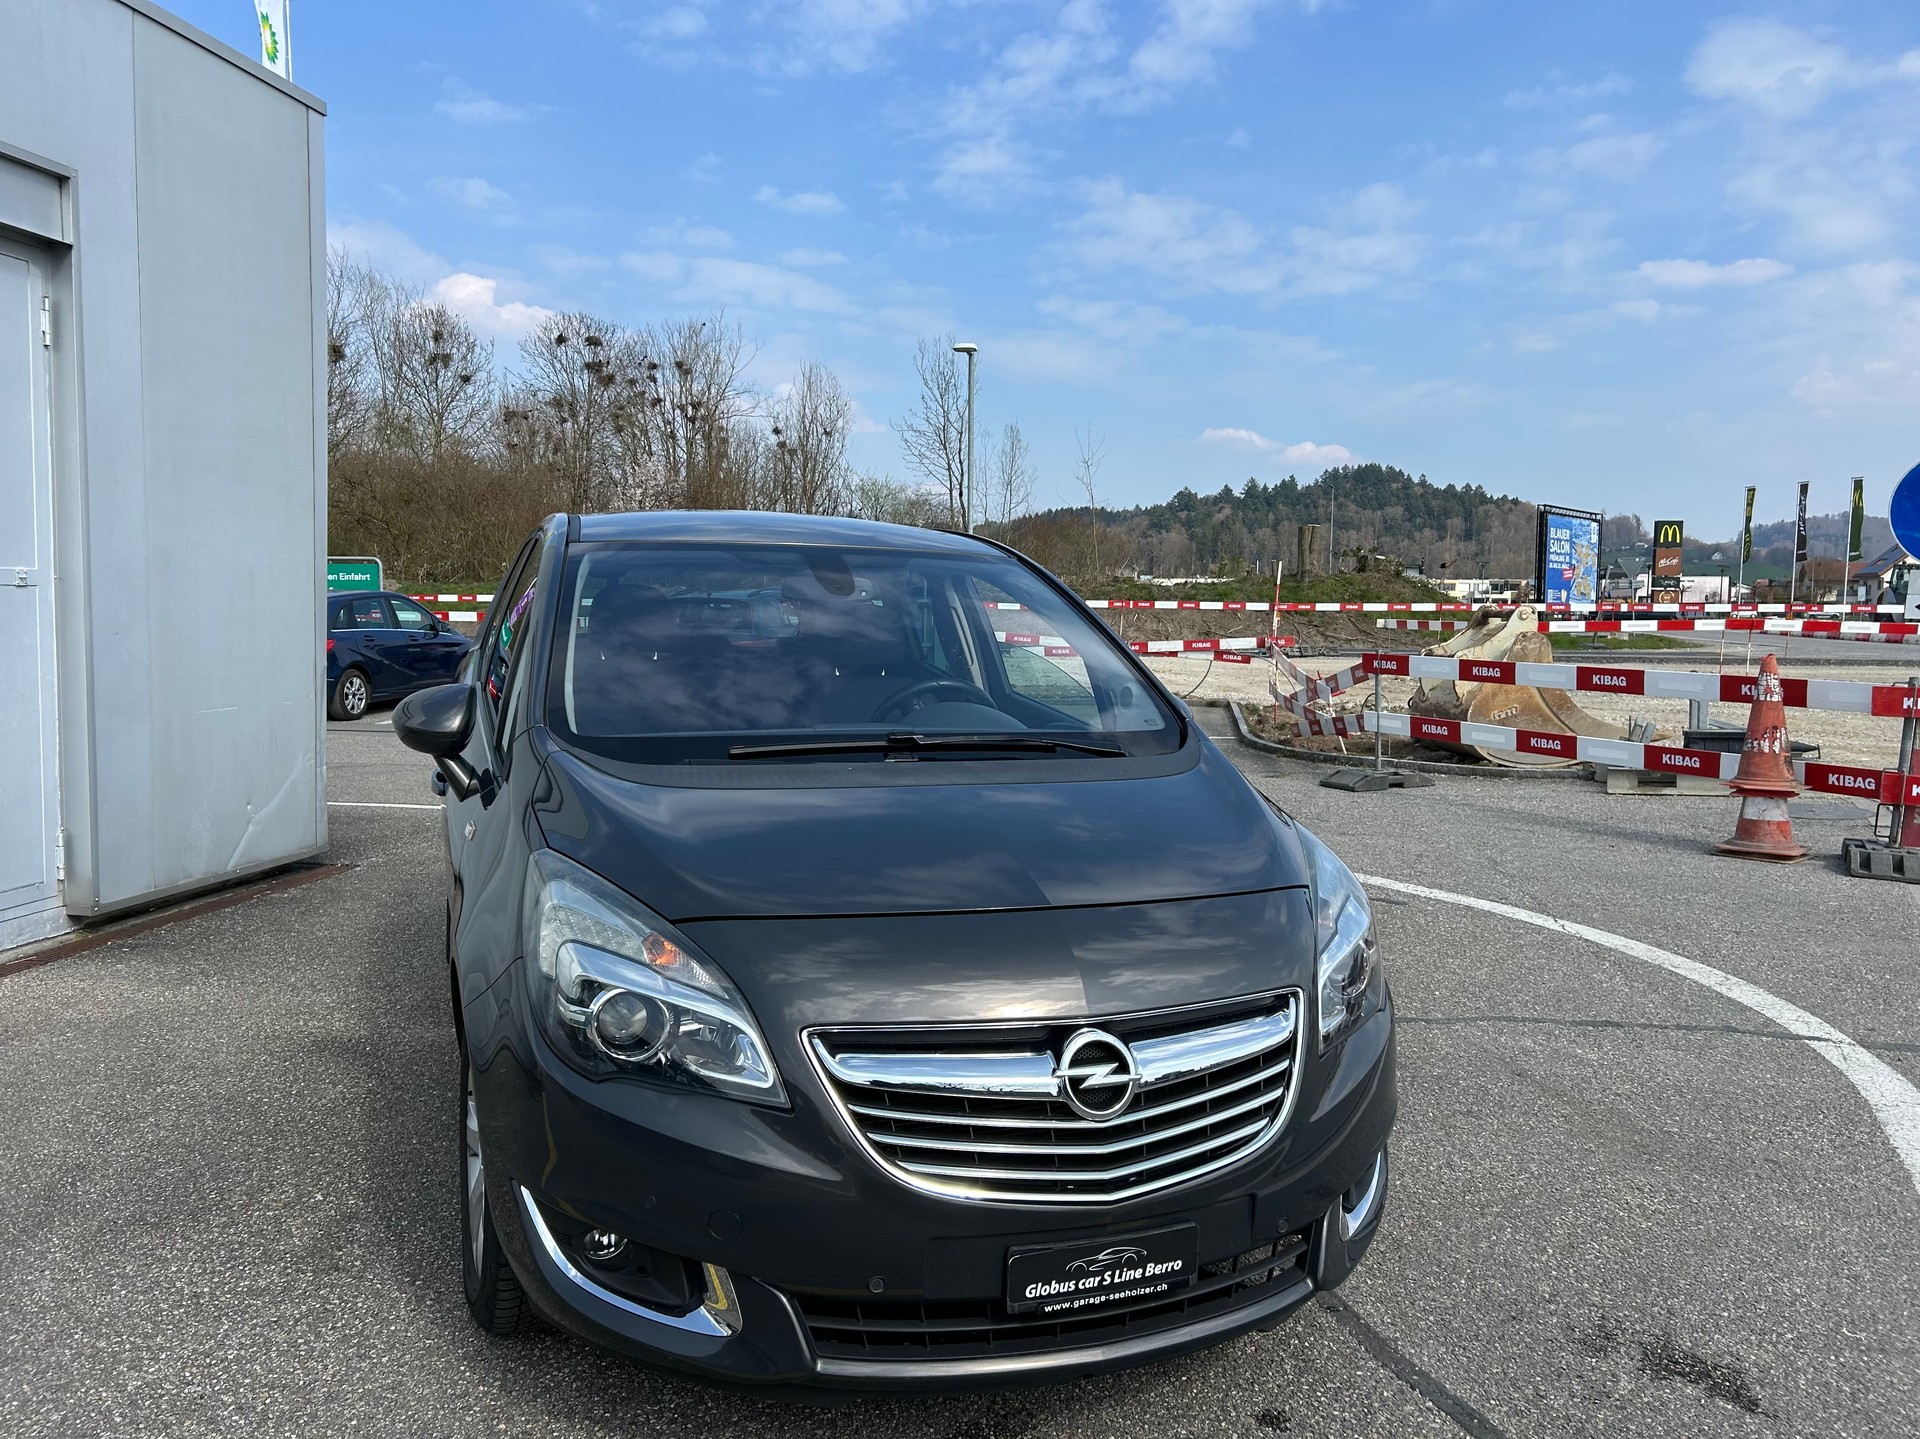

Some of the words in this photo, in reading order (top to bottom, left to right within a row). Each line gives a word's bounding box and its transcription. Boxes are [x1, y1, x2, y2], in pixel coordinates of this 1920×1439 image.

[1550, 527, 1570, 540] BLAUER
[1550, 540, 1570, 554] SALON
[339, 572, 371, 581] Einfahrt
[1472, 666, 1501, 677] KIBAG
[1592, 674, 1627, 687] KIBAG
[1422, 724, 1448, 735] KIBAG
[1530, 737, 1561, 750] KIBAG
[1662, 753, 1700, 768] KIBAG
[1828, 773, 1876, 790] KIBAG
[1025, 1280, 1076, 1298] Globus
[1078, 1275, 1102, 1289] car
[1102, 1270, 1112, 1285] S
[1113, 1267, 1143, 1284] Line
[1144, 1260, 1183, 1277] Berro
[1044, 1283, 1168, 1313] www.garage-seeholzer.ch
